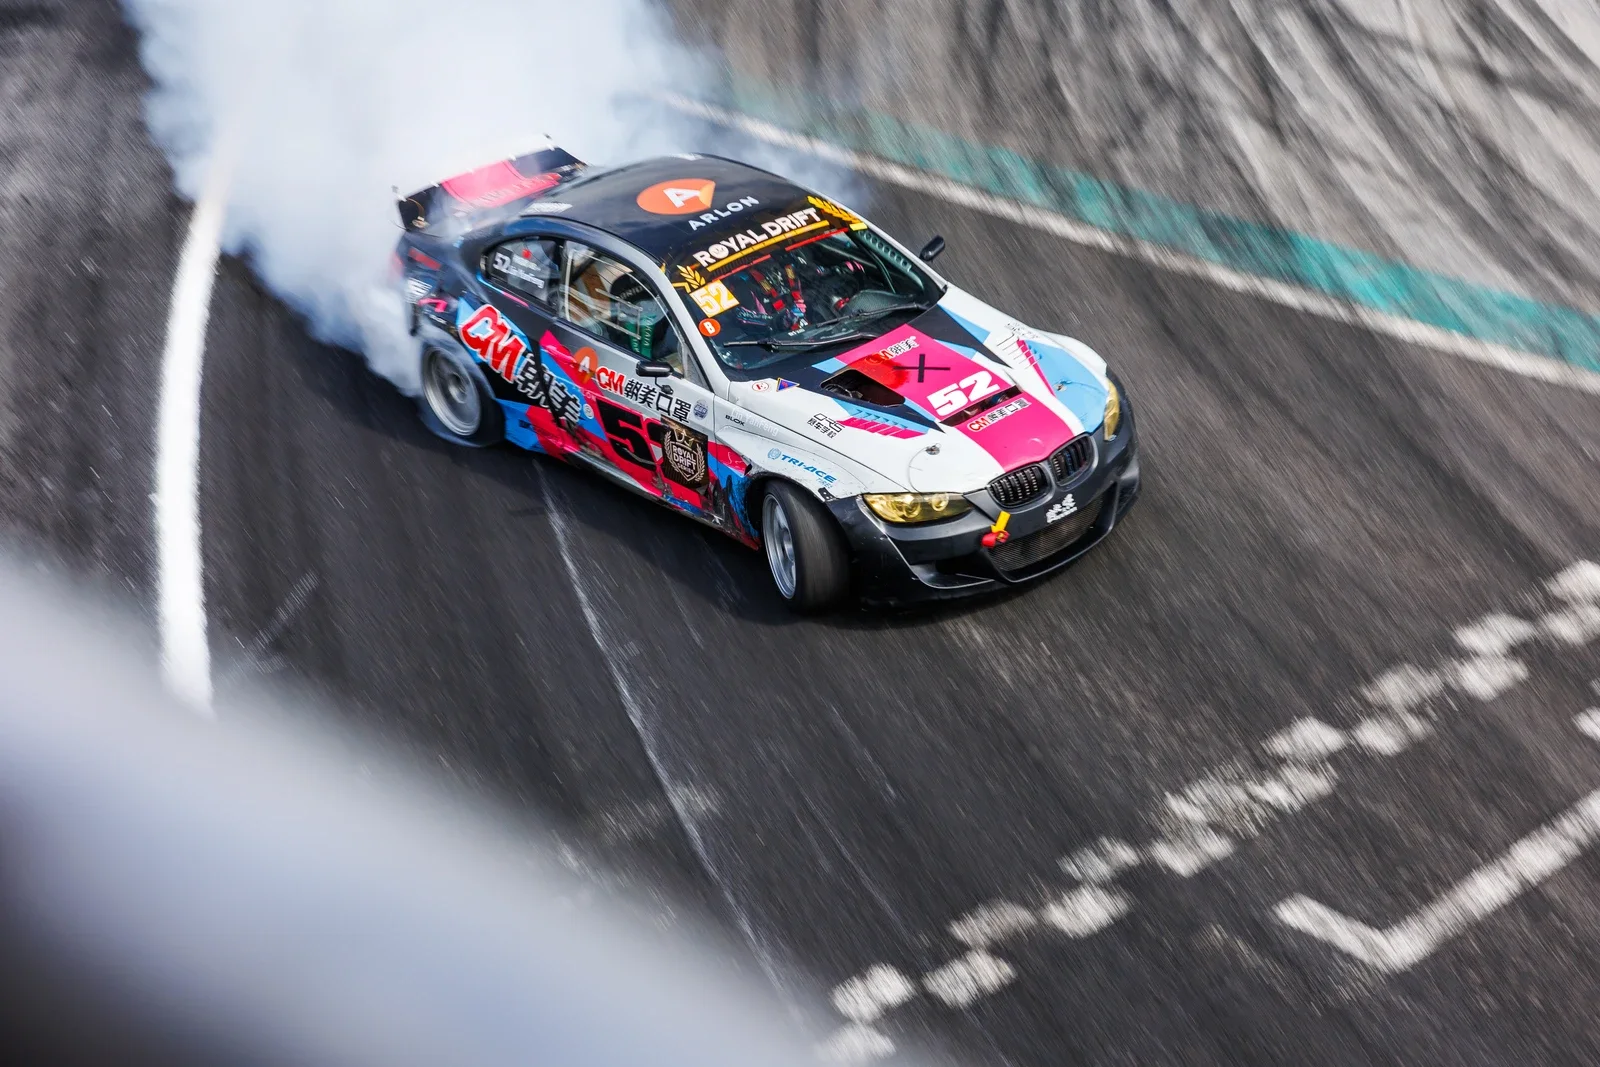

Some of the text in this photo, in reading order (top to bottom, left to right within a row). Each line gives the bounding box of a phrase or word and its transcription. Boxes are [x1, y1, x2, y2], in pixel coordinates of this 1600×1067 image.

[689, 195, 760, 231] ARLON
[692, 207, 822, 267] ROYAL DRIFT
[690, 281, 734, 317] 52
[461, 305, 524, 383] CM
[705, 320, 716, 334] B
[578, 356, 592, 374] A
[596, 367, 626, 396] CM
[624, 379, 692, 424] 朝美口罩
[927, 371, 1000, 417] 52
[968, 416, 991, 432] CM
[672, 445, 697, 462] ROYAL
[674, 453, 697, 471] DRIFT
